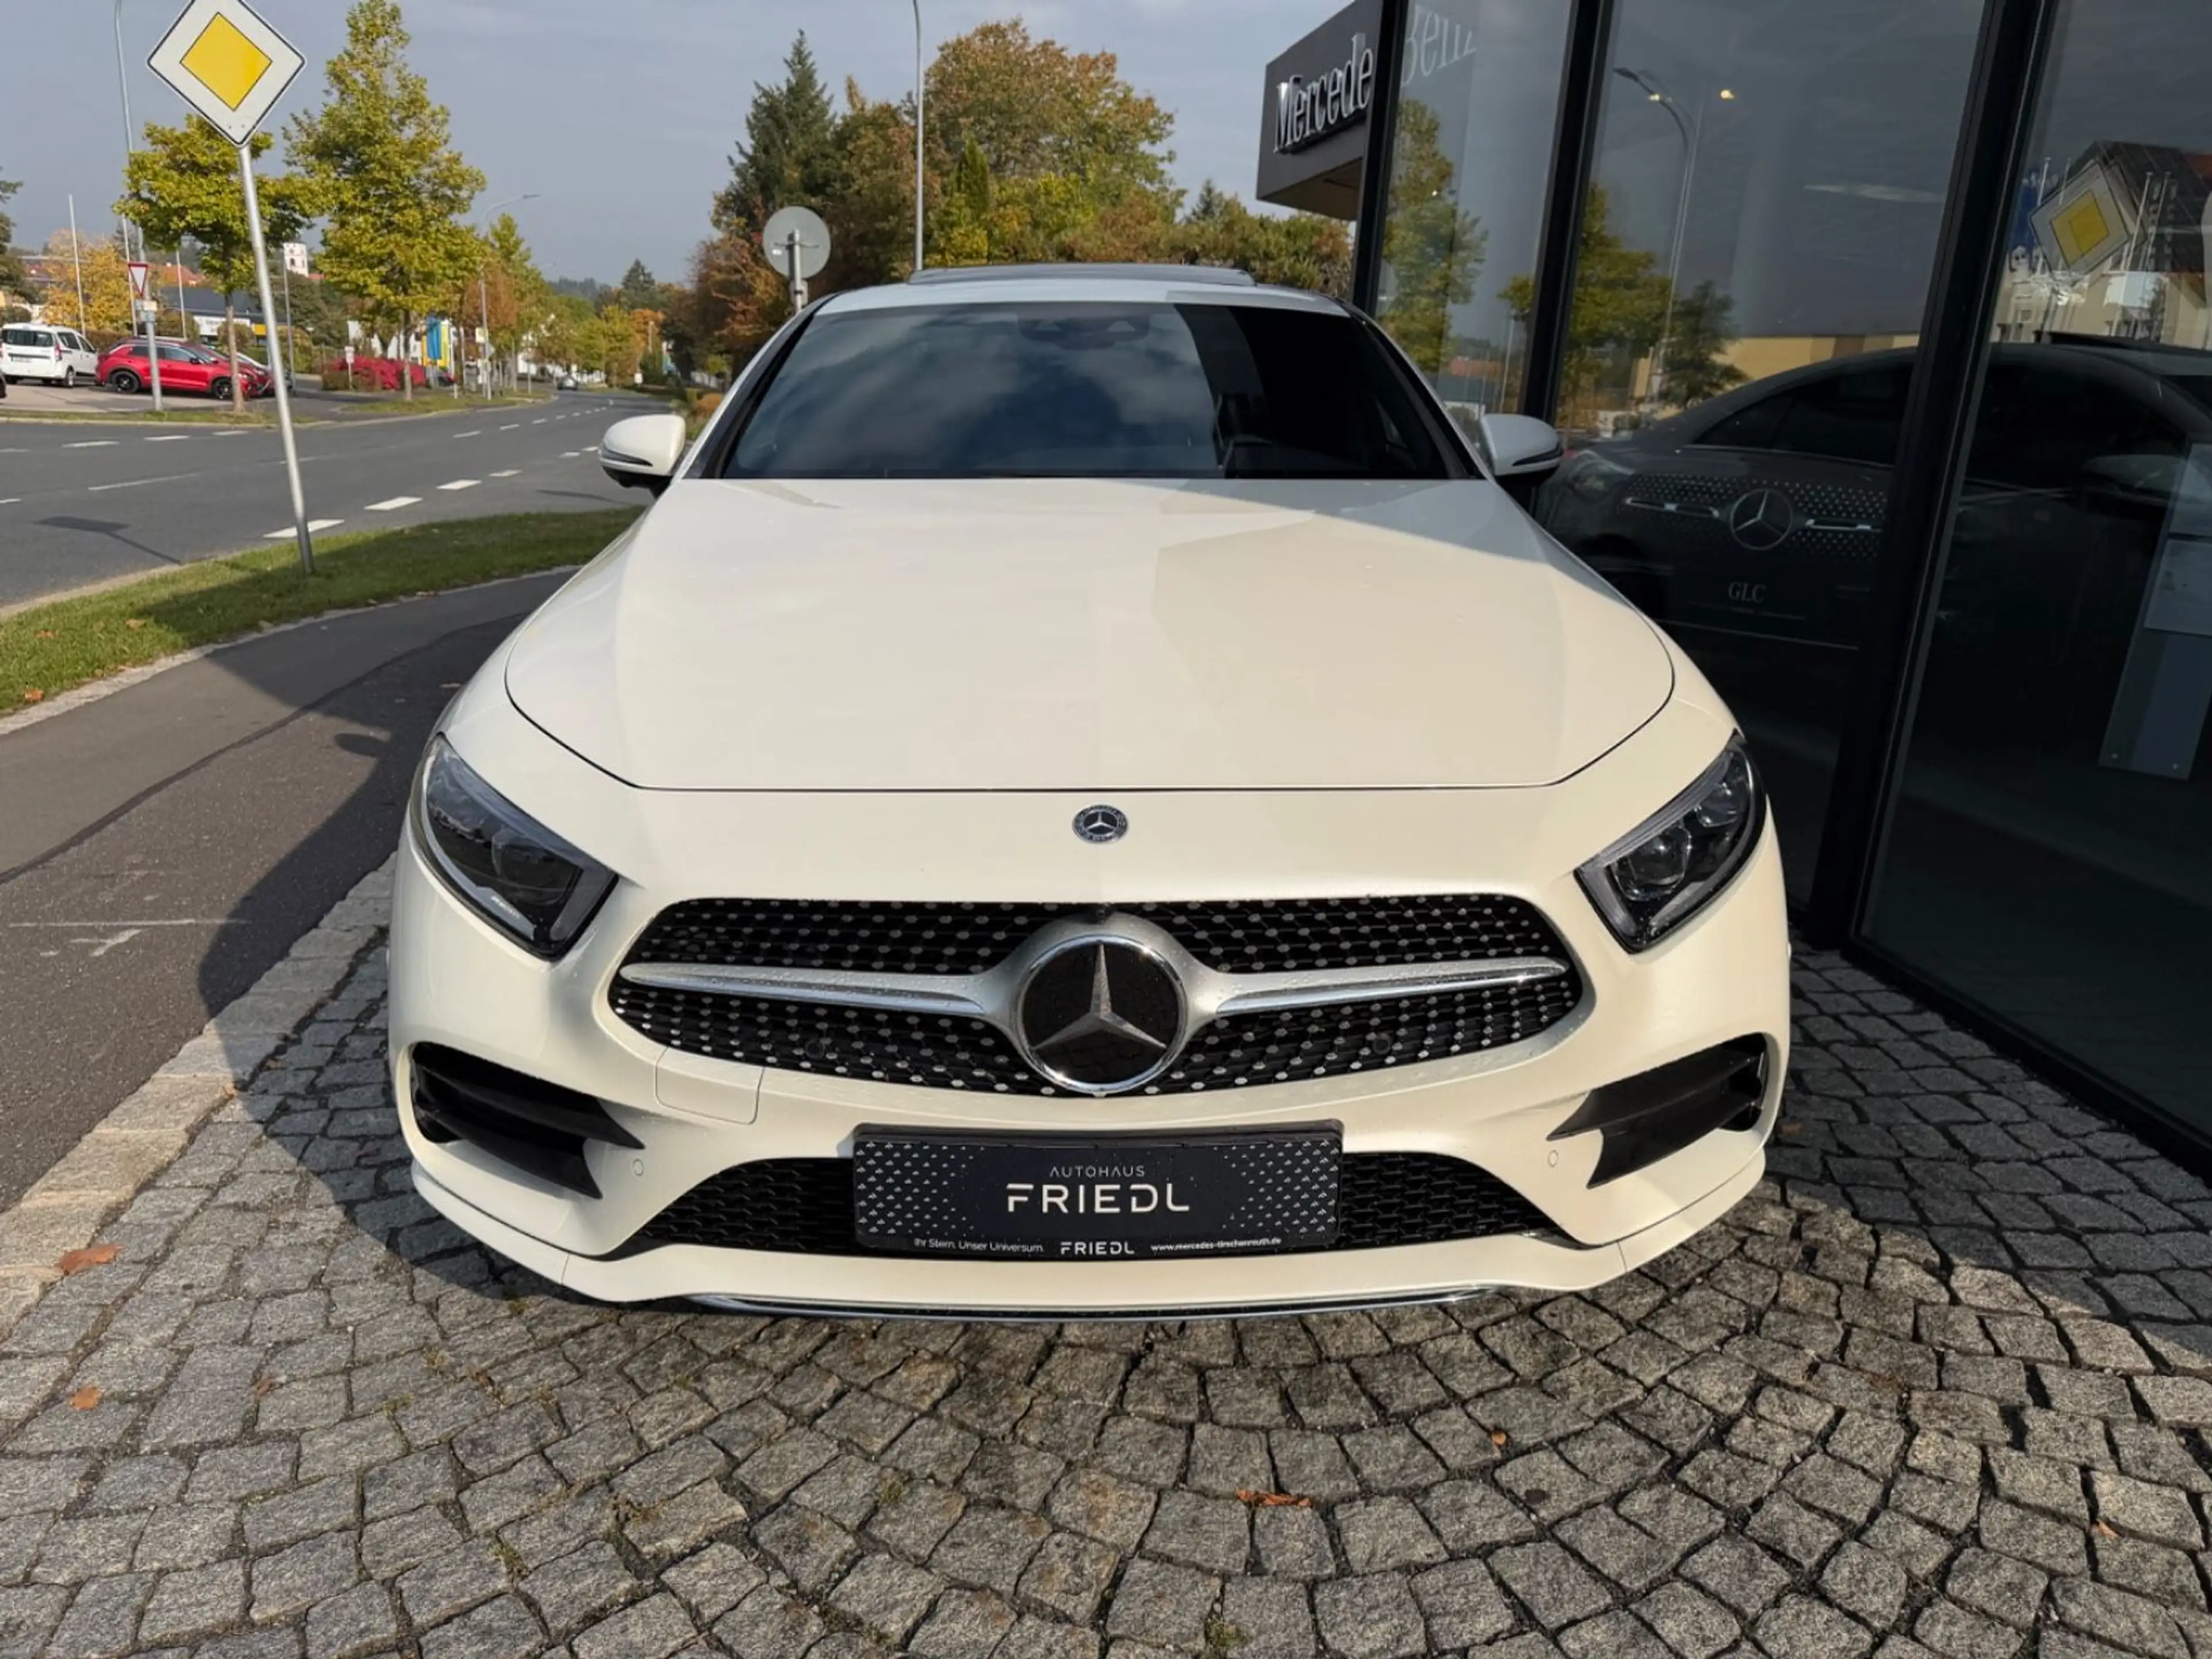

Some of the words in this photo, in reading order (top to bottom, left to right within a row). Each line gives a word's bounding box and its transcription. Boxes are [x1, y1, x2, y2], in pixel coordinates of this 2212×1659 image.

[1274, 32, 1373, 154] Mercede
[1728, 581, 1766, 603] GLC
[1050, 1165, 1145, 1178] AUTOHAUS
[1006, 1183, 1190, 1214] FRIEDL
[958, 1240, 988, 1251] Unser
[1060, 1241, 1135, 1255] FRIEDL
